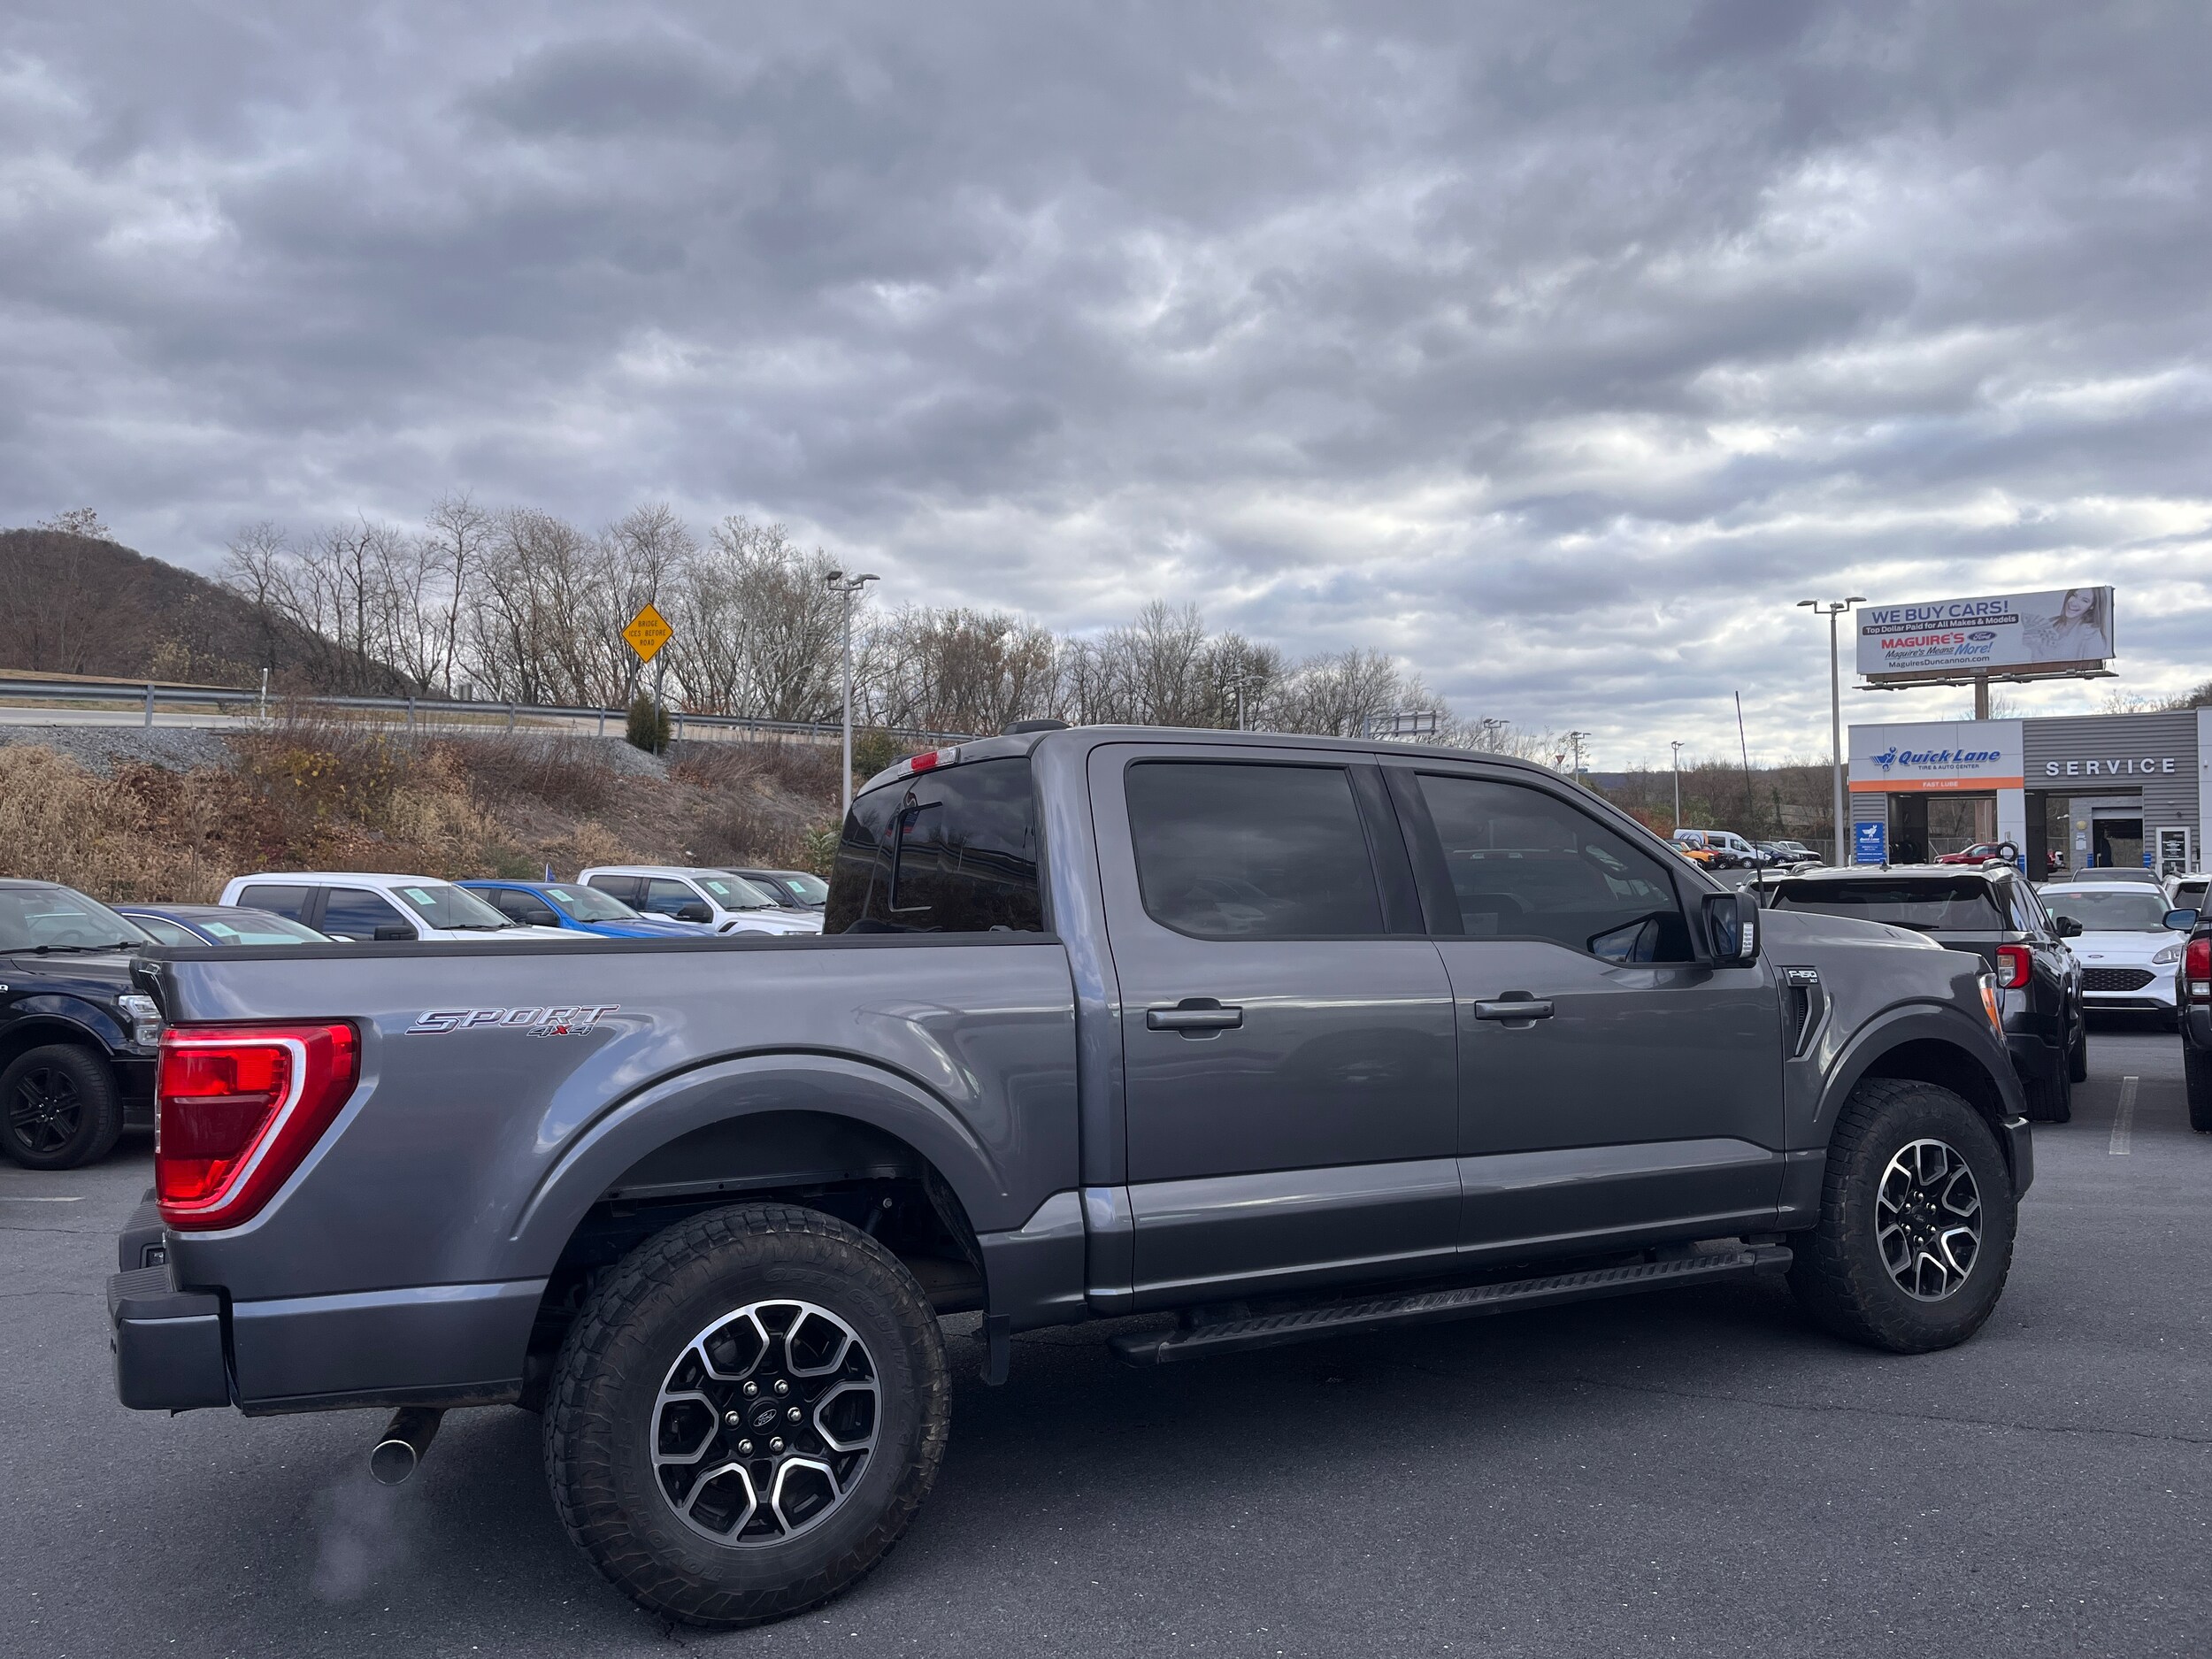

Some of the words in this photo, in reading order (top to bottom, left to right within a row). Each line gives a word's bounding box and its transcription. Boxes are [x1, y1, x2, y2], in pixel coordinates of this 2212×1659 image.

[1871, 610, 1901, 624] WE
[1905, 605, 1945, 622] BUY
[1948, 600, 2008, 618] CARS!
[1985, 616, 2016, 625] Models
[1881, 632, 1964, 649] MAGUIRE'S
[1885, 649, 1925, 660] Maguire's
[1926, 646, 1955, 655] Means
[1954, 641, 1993, 656] More!
[1888, 656, 1990, 668] MaguiresDuncannon.com
[1898, 749, 1951, 766] Quick
[1953, 749, 2001, 763] Lane
[2045, 757, 2177, 776] SERVICE
[404, 1003, 620, 1035] SPORT
